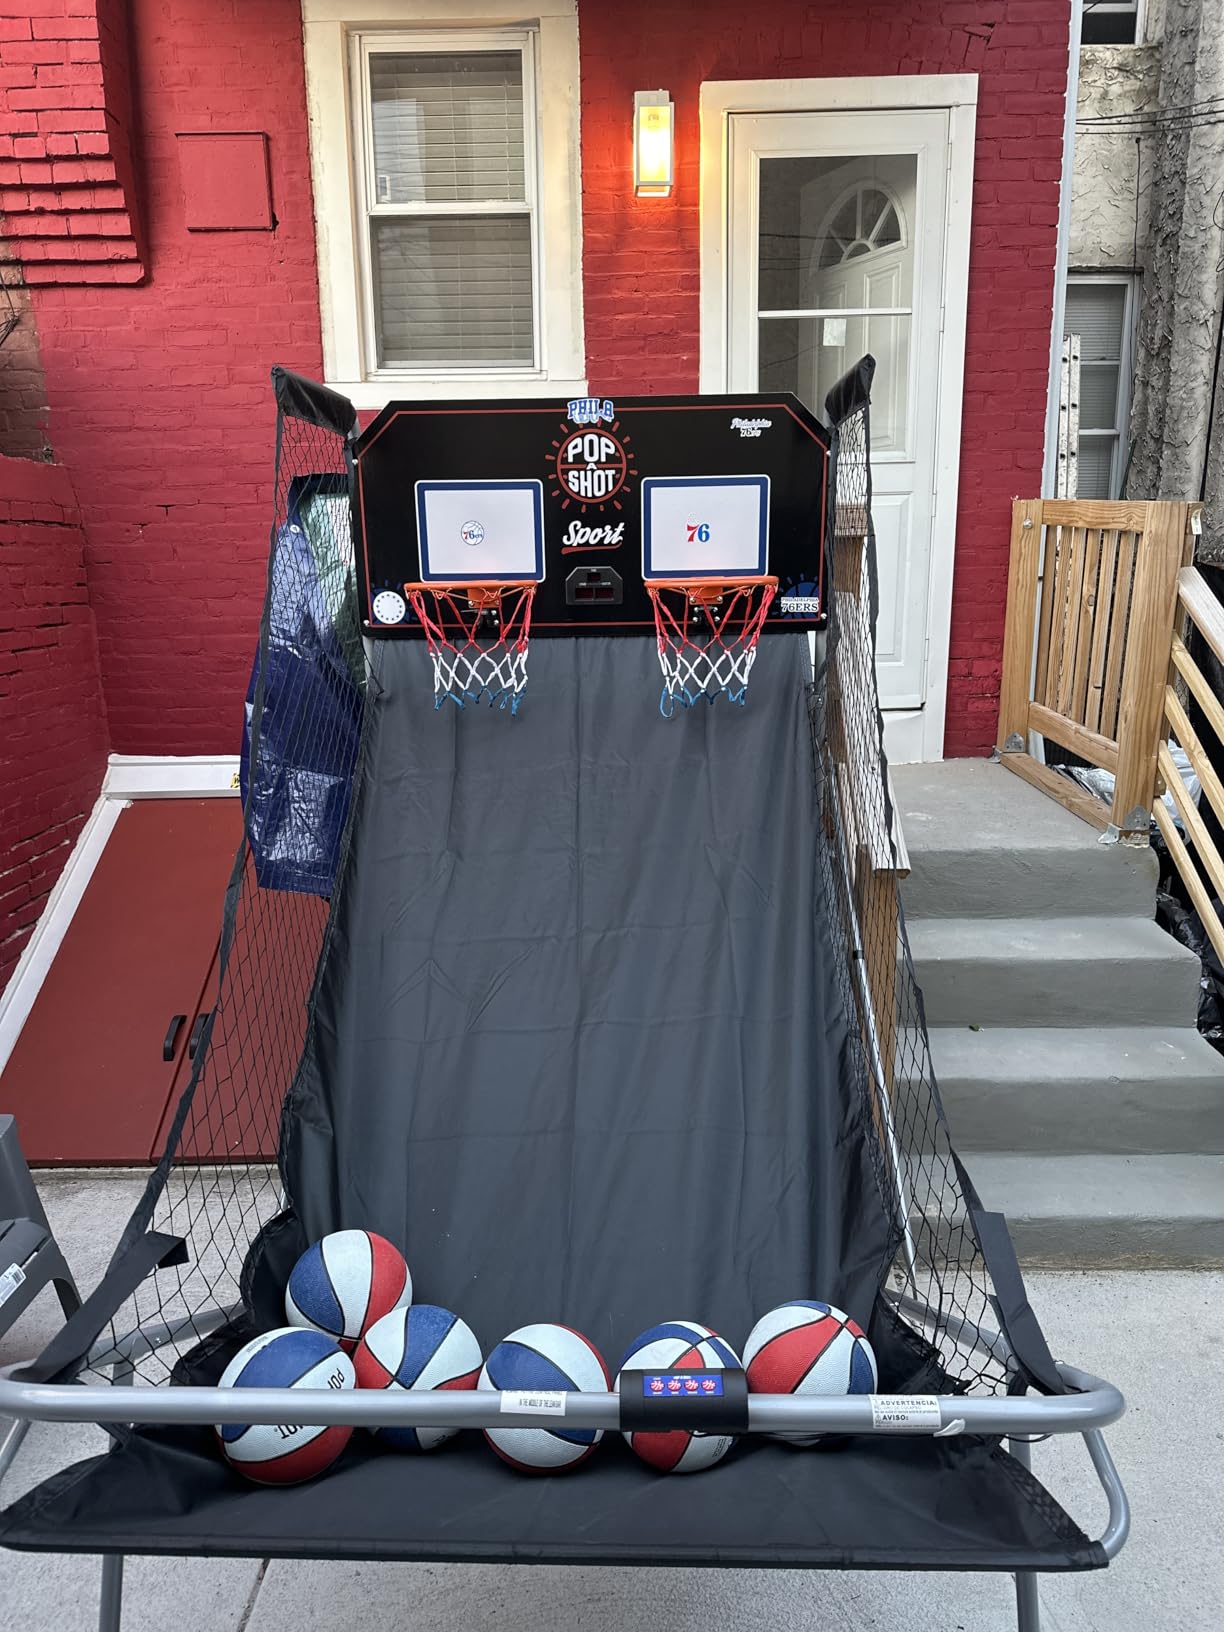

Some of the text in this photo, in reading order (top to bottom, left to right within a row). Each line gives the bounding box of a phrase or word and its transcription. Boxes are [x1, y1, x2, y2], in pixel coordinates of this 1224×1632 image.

[567, 434, 616, 463] POP
[586, 462, 597, 470] A
[568, 469, 616, 497] SHOT
[562, 520, 625, 546] Sport
[687, 523, 710, 543] 76
[781, 602, 818, 612] 76ERS
